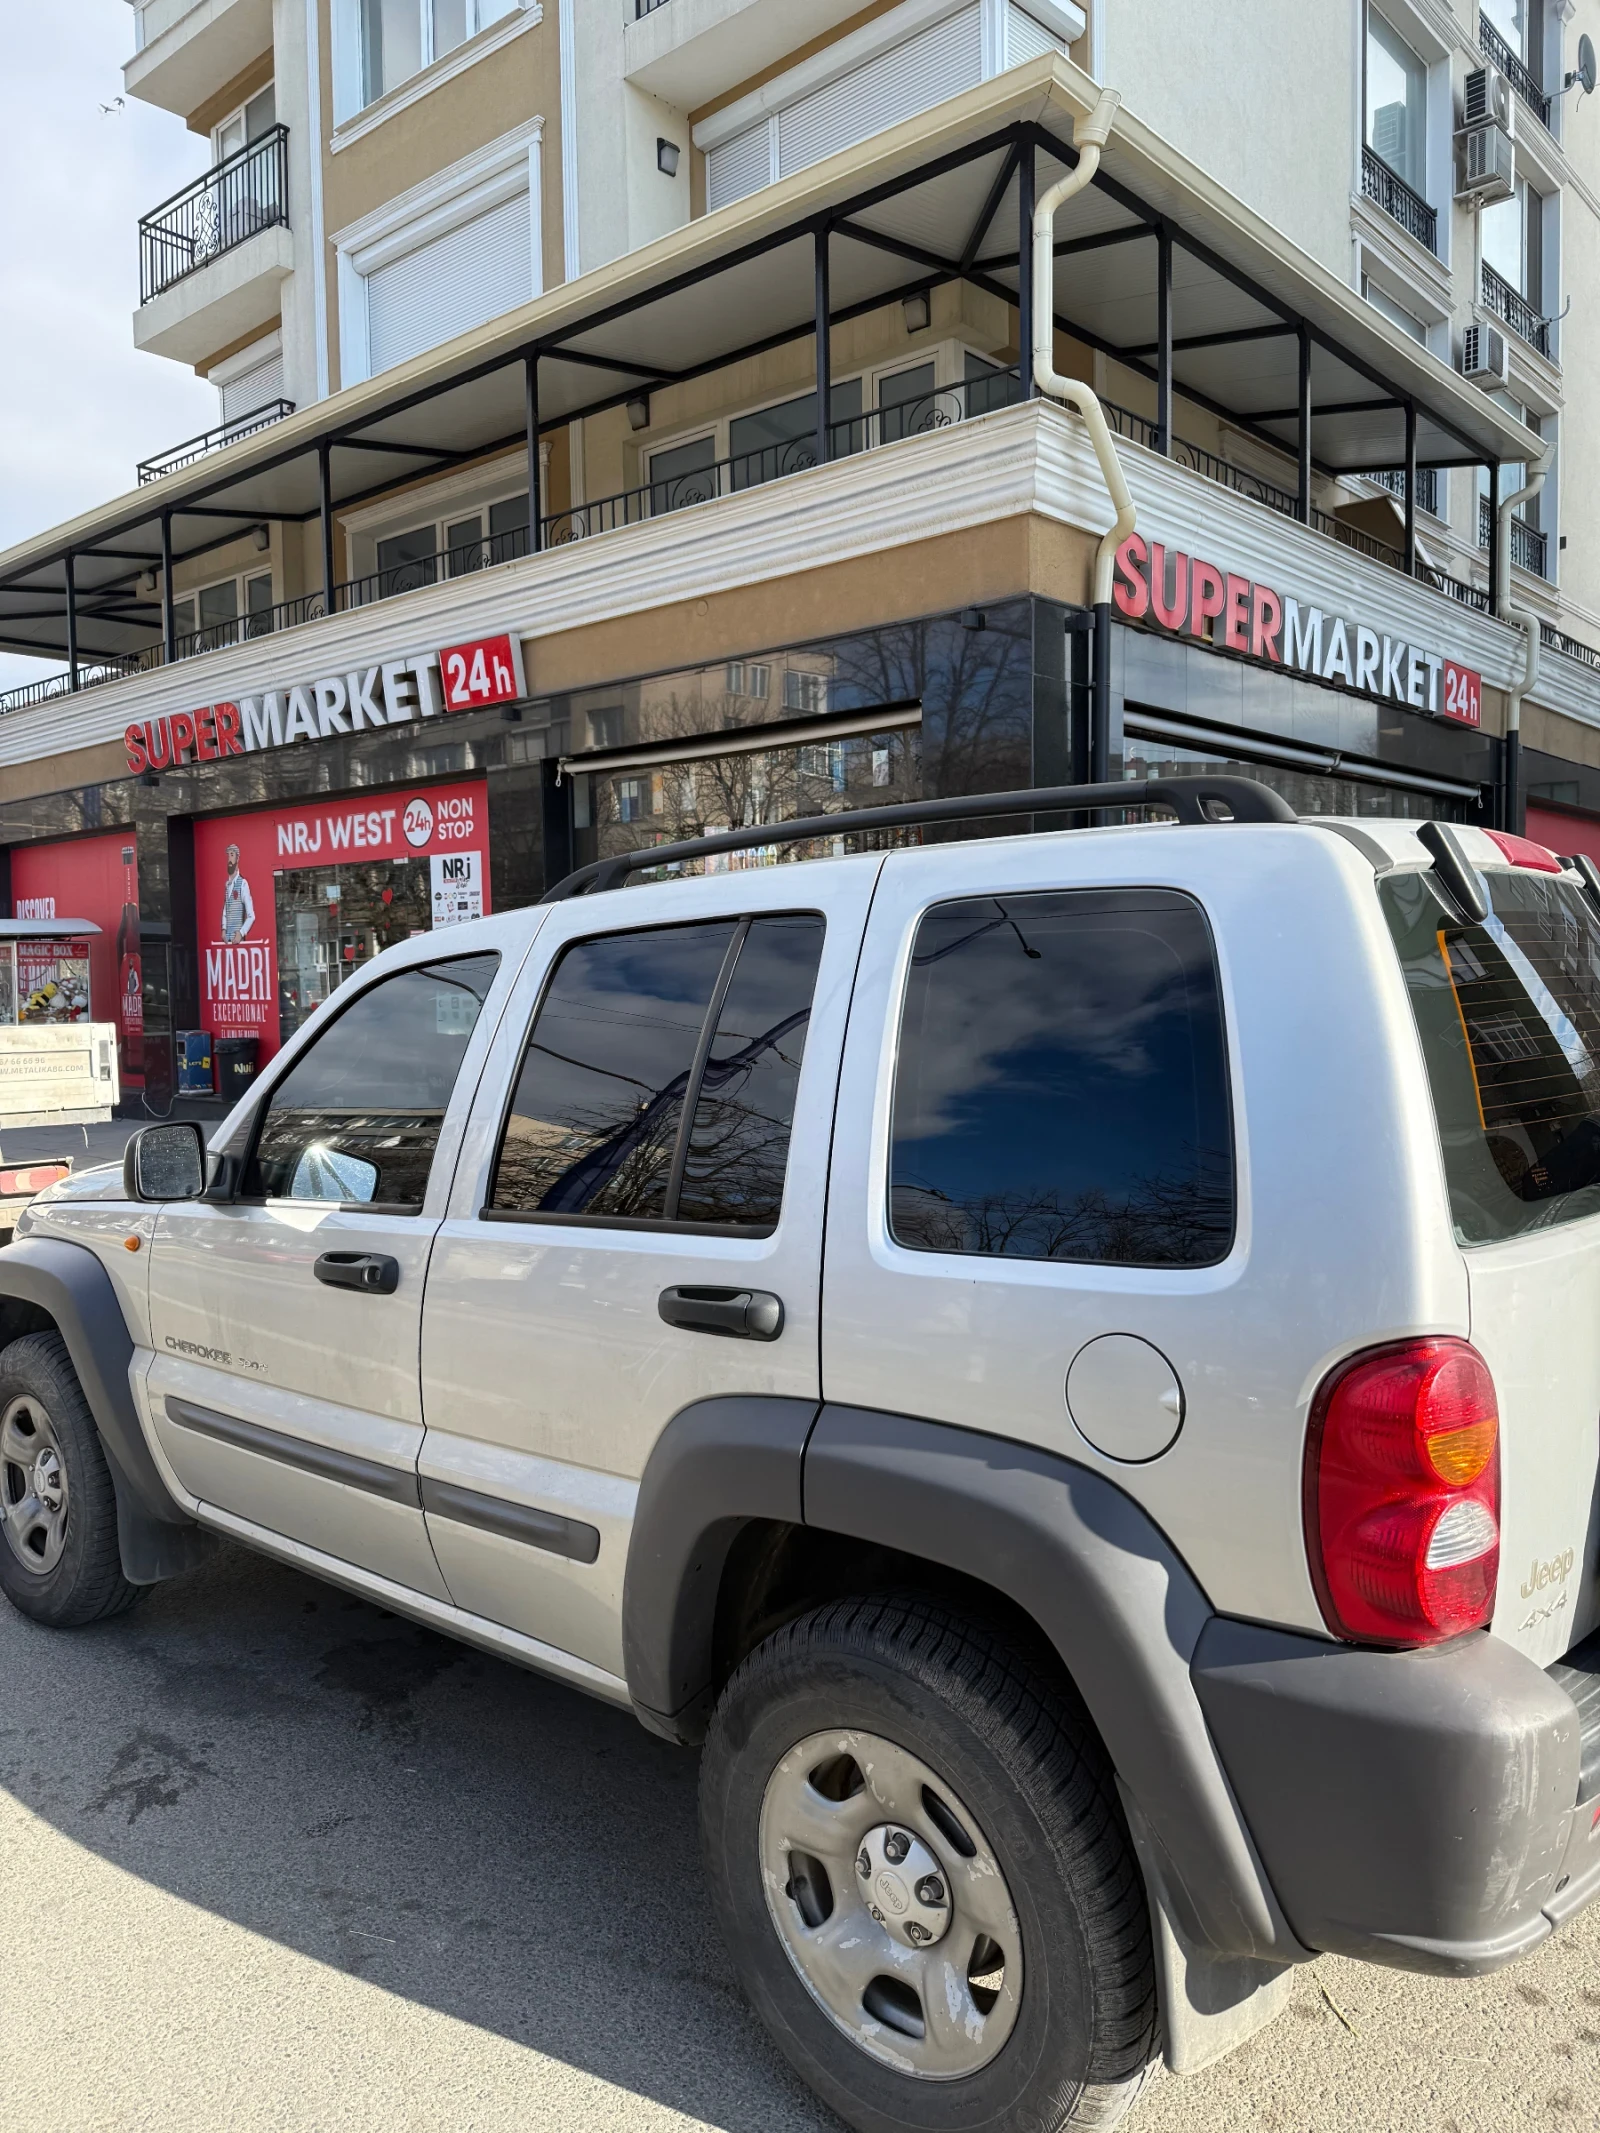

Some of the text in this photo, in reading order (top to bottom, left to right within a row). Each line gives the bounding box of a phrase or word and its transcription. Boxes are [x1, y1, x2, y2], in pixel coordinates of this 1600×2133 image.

[1113, 532, 1477, 721] SUPERMARKET 24h
[124, 648, 512, 774] SUPERMARKET 24h
[405, 811, 431, 833] 24h
[437, 797, 473, 820] NON
[277, 809, 396, 856] NRJ WEST
[438, 820, 474, 840] STOP
[18, 944, 51, 957] MAGIC
[53, 944, 73, 957] BOX
[165, 1336, 232, 1365] CHEROKEE
[1520, 1546, 1574, 1599] Jeep
[880, 1879, 902, 1909] Jeep
